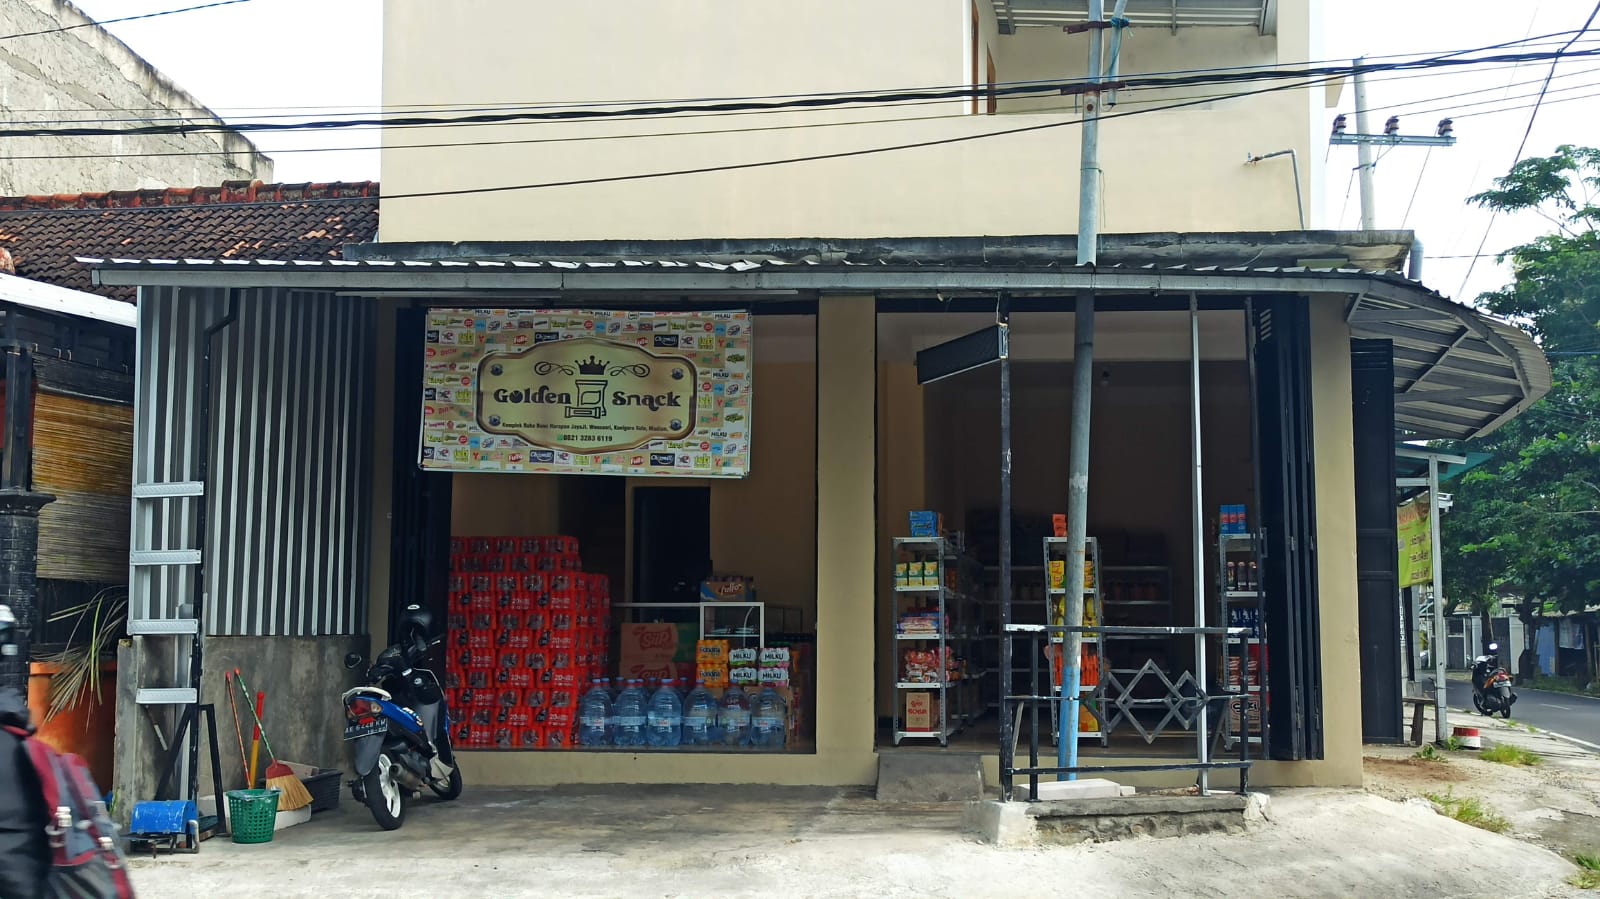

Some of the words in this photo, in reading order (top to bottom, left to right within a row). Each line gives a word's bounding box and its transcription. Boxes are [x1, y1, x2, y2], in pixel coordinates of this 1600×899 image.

[493, 385, 572, 404] Golden
[612, 391, 681, 411] Snack
[732, 652, 752, 660] MILKU
[764, 652, 784, 660] MILKU
[732, 671, 752, 679] MILKU
[762, 671, 782, 679] MILKU
